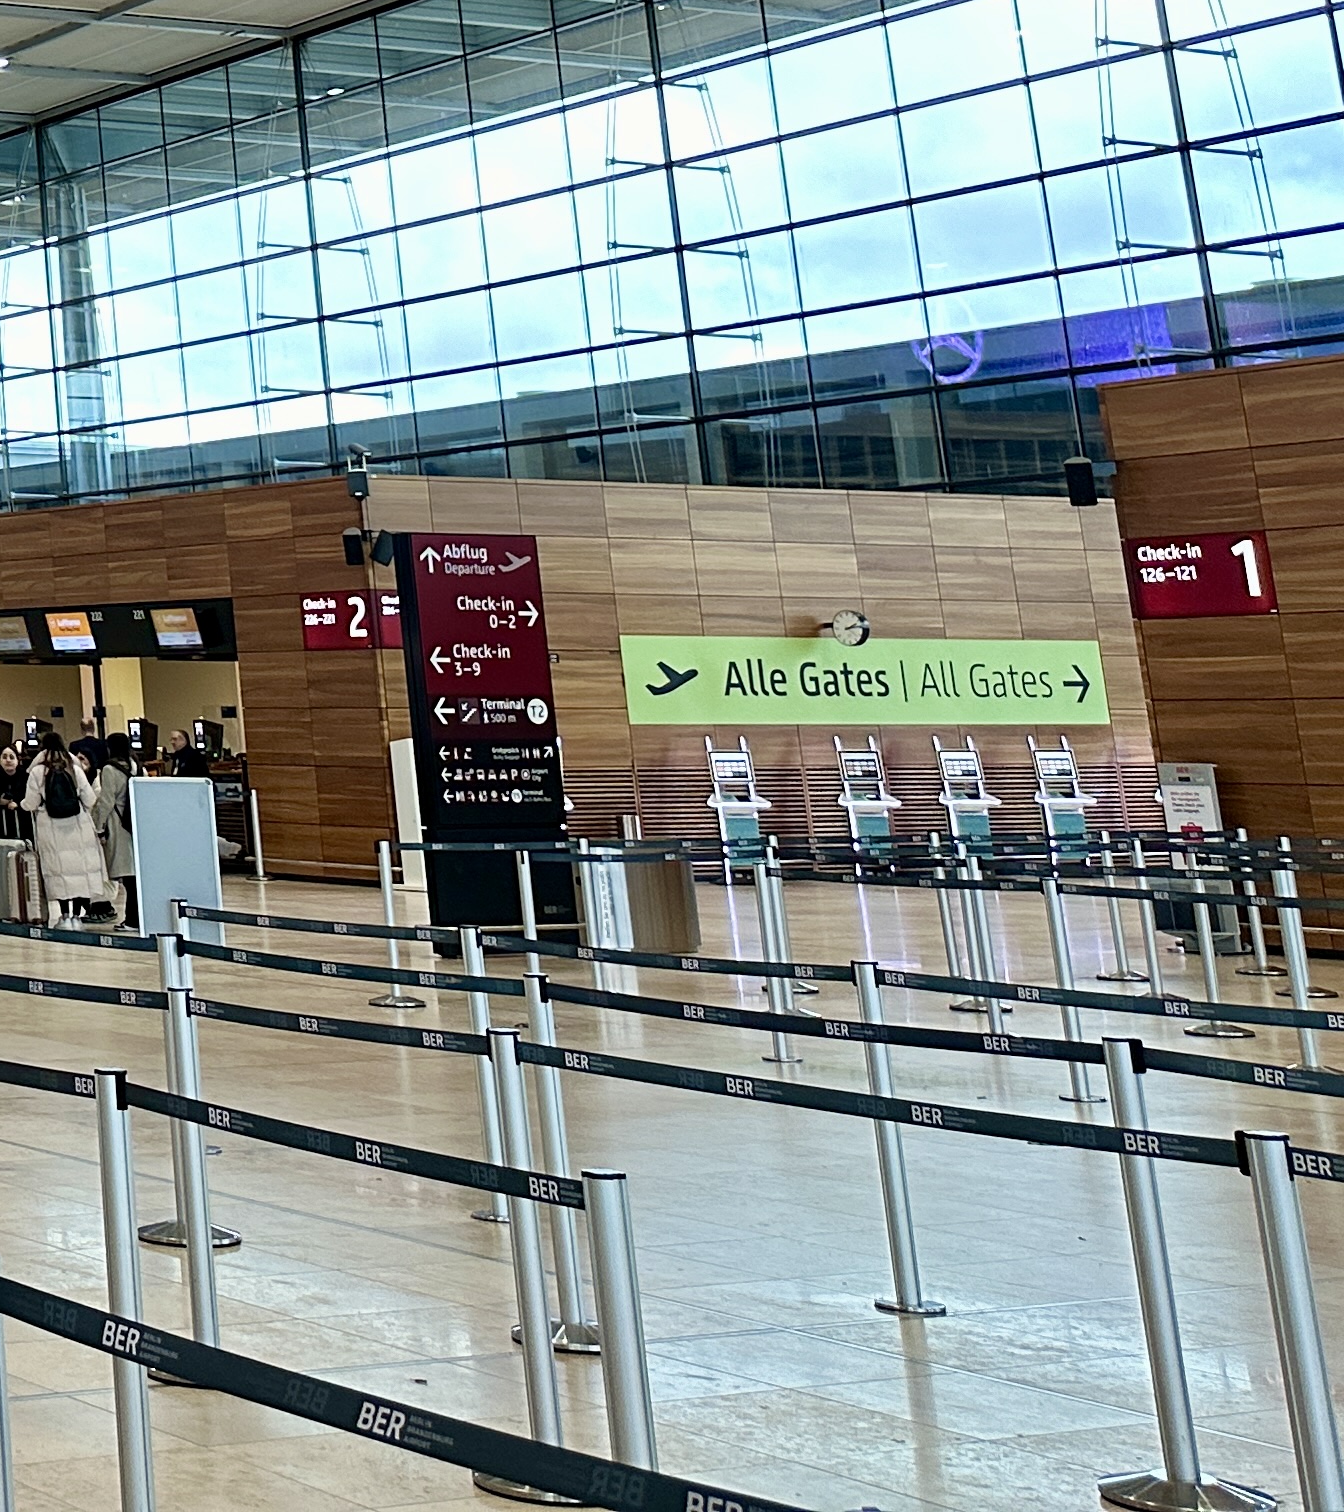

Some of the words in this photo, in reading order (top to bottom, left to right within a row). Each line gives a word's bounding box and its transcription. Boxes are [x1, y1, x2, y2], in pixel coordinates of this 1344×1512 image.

[443, 543, 488, 563] Abflug
[1137, 543, 1202, 562] Check-in
[444, 562, 496, 576] Departure
[1230, 539, 1262, 597] 1
[303, 597, 336, 610] Check-in
[456, 595, 515, 611] Check-in
[347, 596, 368, 638] 2
[489, 614, 517, 629] 0–2
[453, 644, 511, 659] Check-in
[454, 662, 481, 676] 3–9
[724, 658, 787, 697] Alle
[798, 661, 890, 698] Gates
[920, 660, 961, 698] All
[969, 662, 1054, 699] Gates
[480, 698, 525, 710] Terminal
[530, 705, 544, 718] T2
[490, 713, 506, 723] 500
[507, 714, 517, 723] m
[232, 950, 247, 962] BER
[577, 947, 594, 959] BER
[884, 972, 905, 986] BER
[1018, 987, 1040, 1001] BER
[683, 1004, 705, 1020] BER
[1164, 1001, 1190, 1016] BER
[299, 1017, 320, 1033] BER
[825, 1020, 849, 1039] BER
[422, 1030, 444, 1048] BER
[983, 1035, 1010, 1052] BER
[564, 1051, 589, 1070] BER
[74, 1075, 94, 1096] BER
[726, 1076, 754, 1096] BER
[1253, 1066, 1286, 1087] BER
[208, 1106, 231, 1129] BER
[911, 1102, 944, 1125] BER
[355, 1141, 381, 1164] BER
[1122, 1131, 1161, 1155] BER
[1291, 1151, 1333, 1177] BER
[528, 1176, 559, 1201] BER
[102, 1320, 141, 1355] BER
[356, 1401, 406, 1440] BER
[686, 1490, 744, 1512] BER
